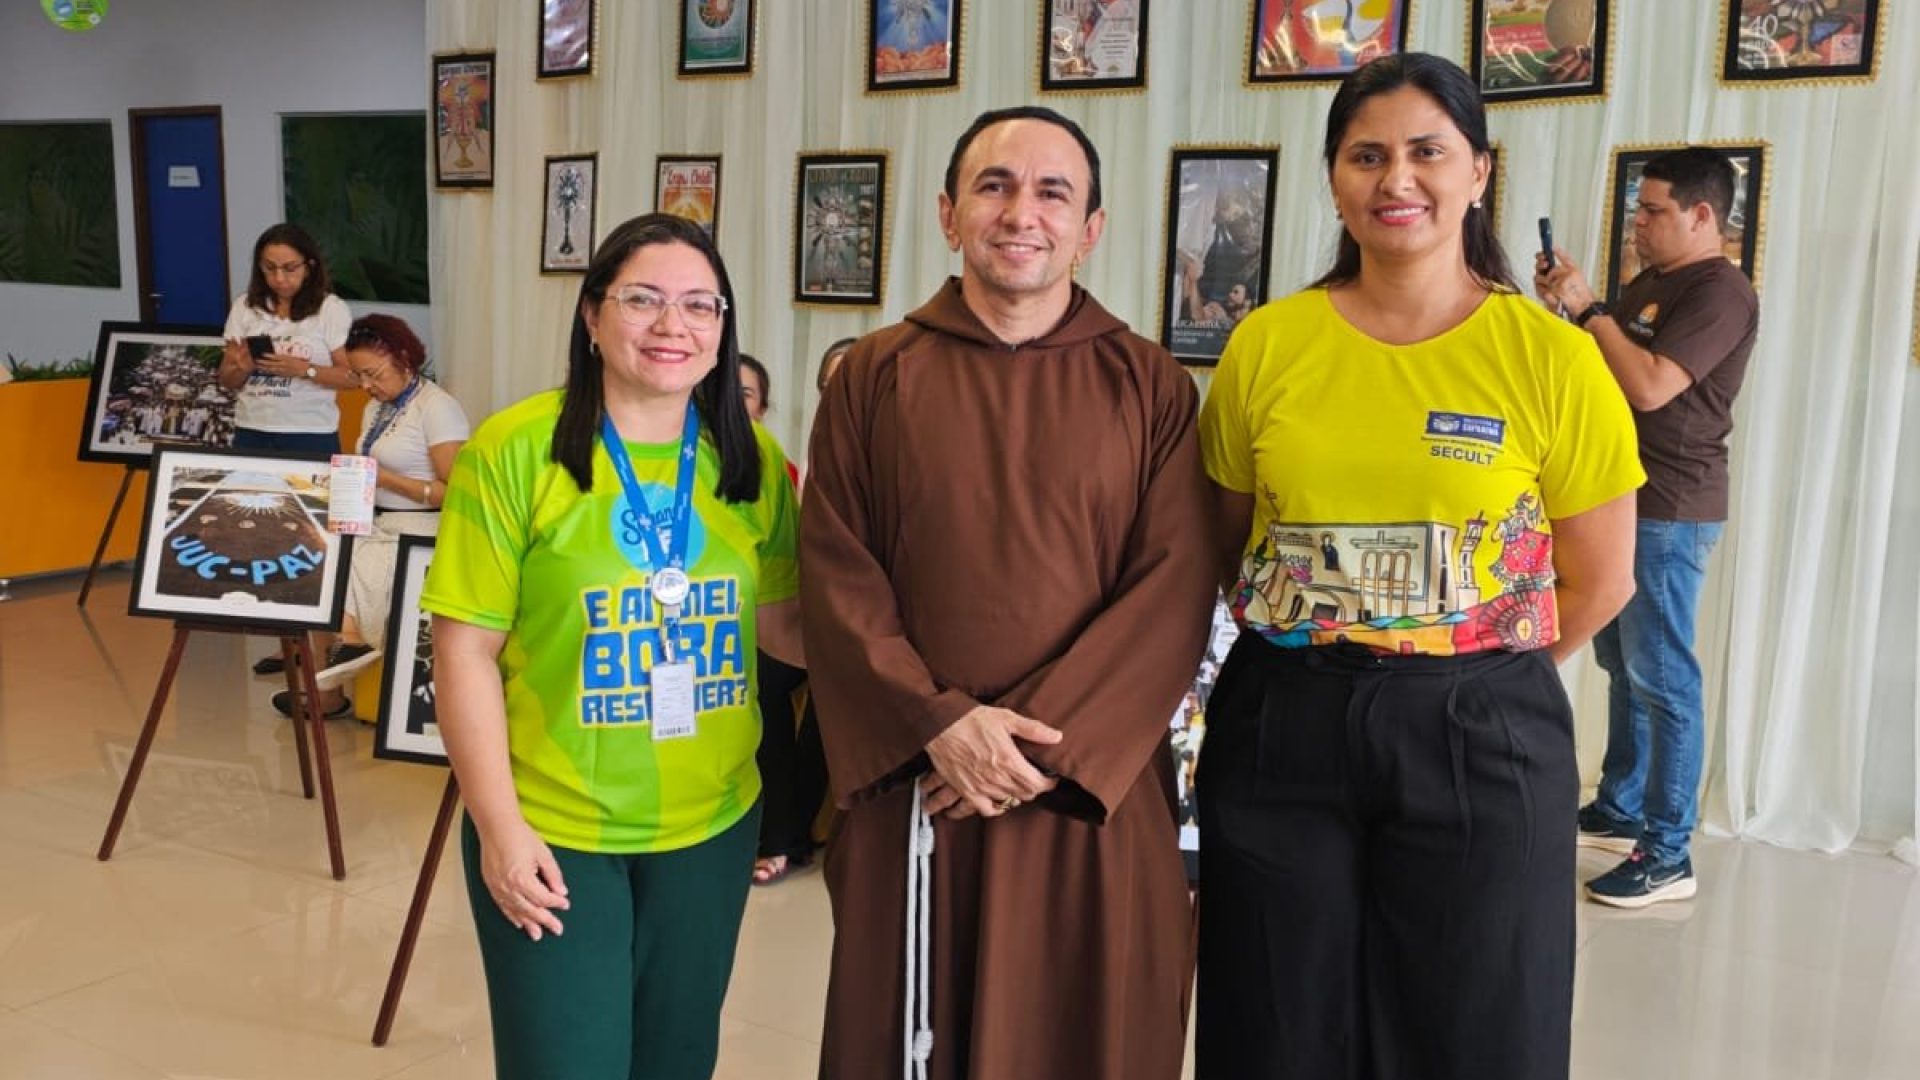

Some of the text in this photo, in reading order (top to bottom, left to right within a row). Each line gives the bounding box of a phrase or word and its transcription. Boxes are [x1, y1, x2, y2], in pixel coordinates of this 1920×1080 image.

[1430, 445, 1494, 465] SECULT
[584, 590, 609, 628] E
[583, 620, 744, 690] BORA
